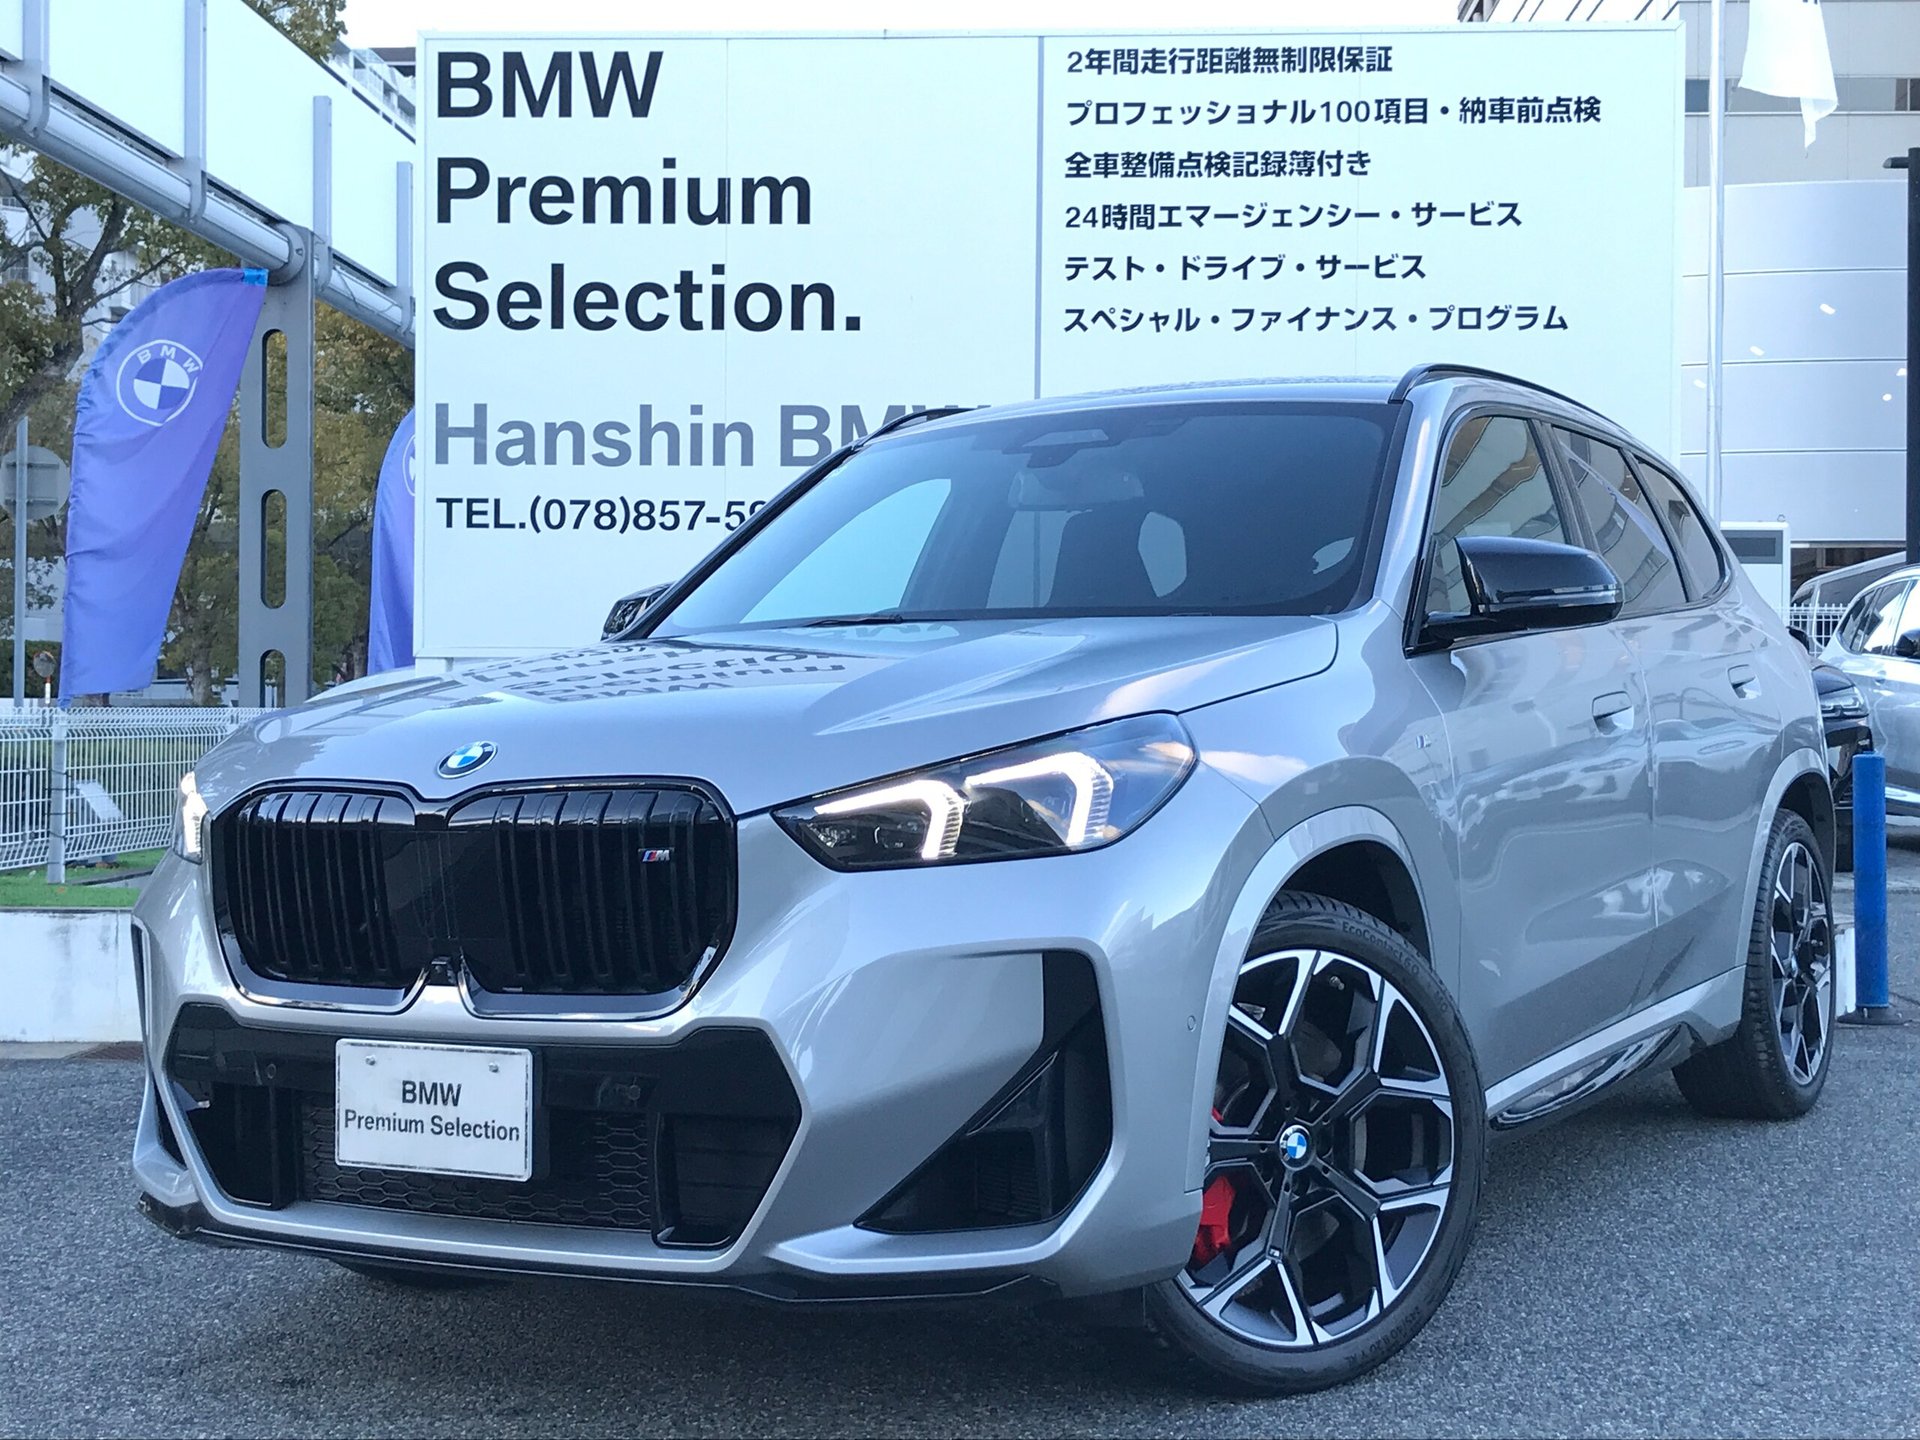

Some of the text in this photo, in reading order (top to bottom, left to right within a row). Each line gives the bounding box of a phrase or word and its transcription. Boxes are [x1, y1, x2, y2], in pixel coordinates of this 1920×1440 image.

[1067, 46, 1393, 76] 2年間走行距離無制限保証
[438, 51, 663, 117] BMW
[1067, 96, 1602, 126] プロフェッショナル100項目・納車前点検
[1064, 150, 1371, 179] 全車整備点検記録簿付き
[437, 157, 811, 225] Premium
[1065, 201, 1523, 231] 24時間エマージェンシー・サービス
[1064, 253, 1427, 281] テスト・ドライブ・サービス
[433, 261, 862, 332] Selection.
[1064, 304, 1569, 333] スペシャル・ファイナンス・プログラム
[136, 344, 200, 374] BMW
[434, 402, 991, 468] Hanshin BM
[402, 1080, 462, 1107] BMW
[344, 1109, 520, 1142] Premium Selection
